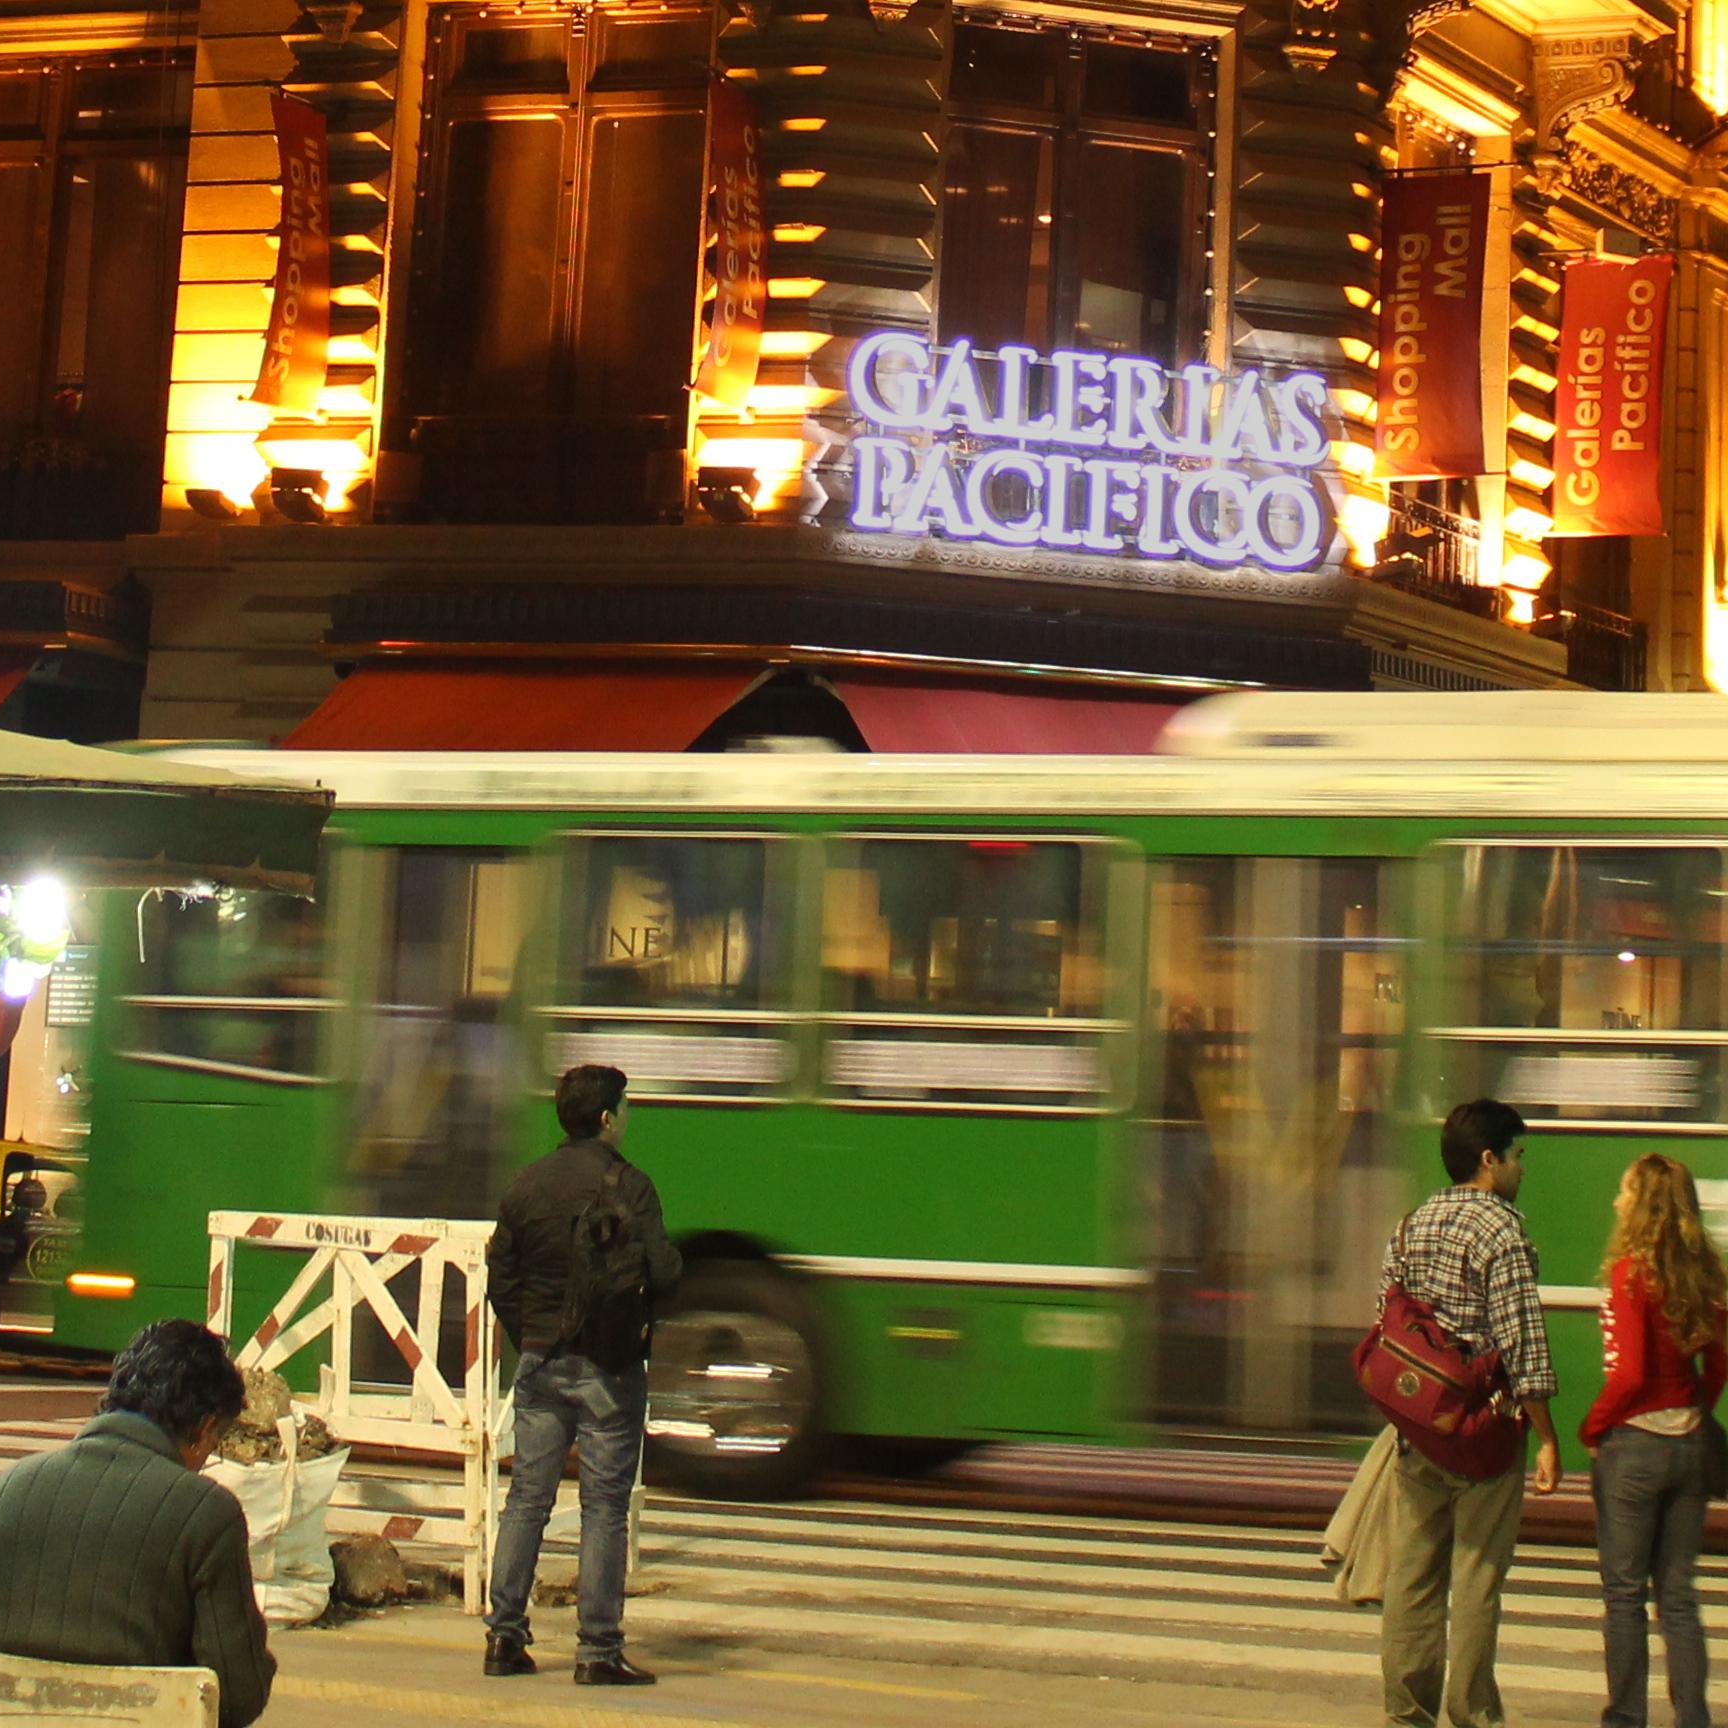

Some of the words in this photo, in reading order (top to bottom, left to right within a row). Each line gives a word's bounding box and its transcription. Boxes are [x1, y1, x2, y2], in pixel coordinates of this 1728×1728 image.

[268, 155, 307, 384] Shopping
[1433, 203, 1473, 300] Mall
[847, 326, 1332, 468] GALERIAS
[1383, 232, 1432, 453] Shopping
[1565, 326, 1607, 507] Galerías
[1611, 278, 1657, 452] Pacífico
[847, 432, 1325, 571] PACIFICO
[607, 925, 662, 959] NE
